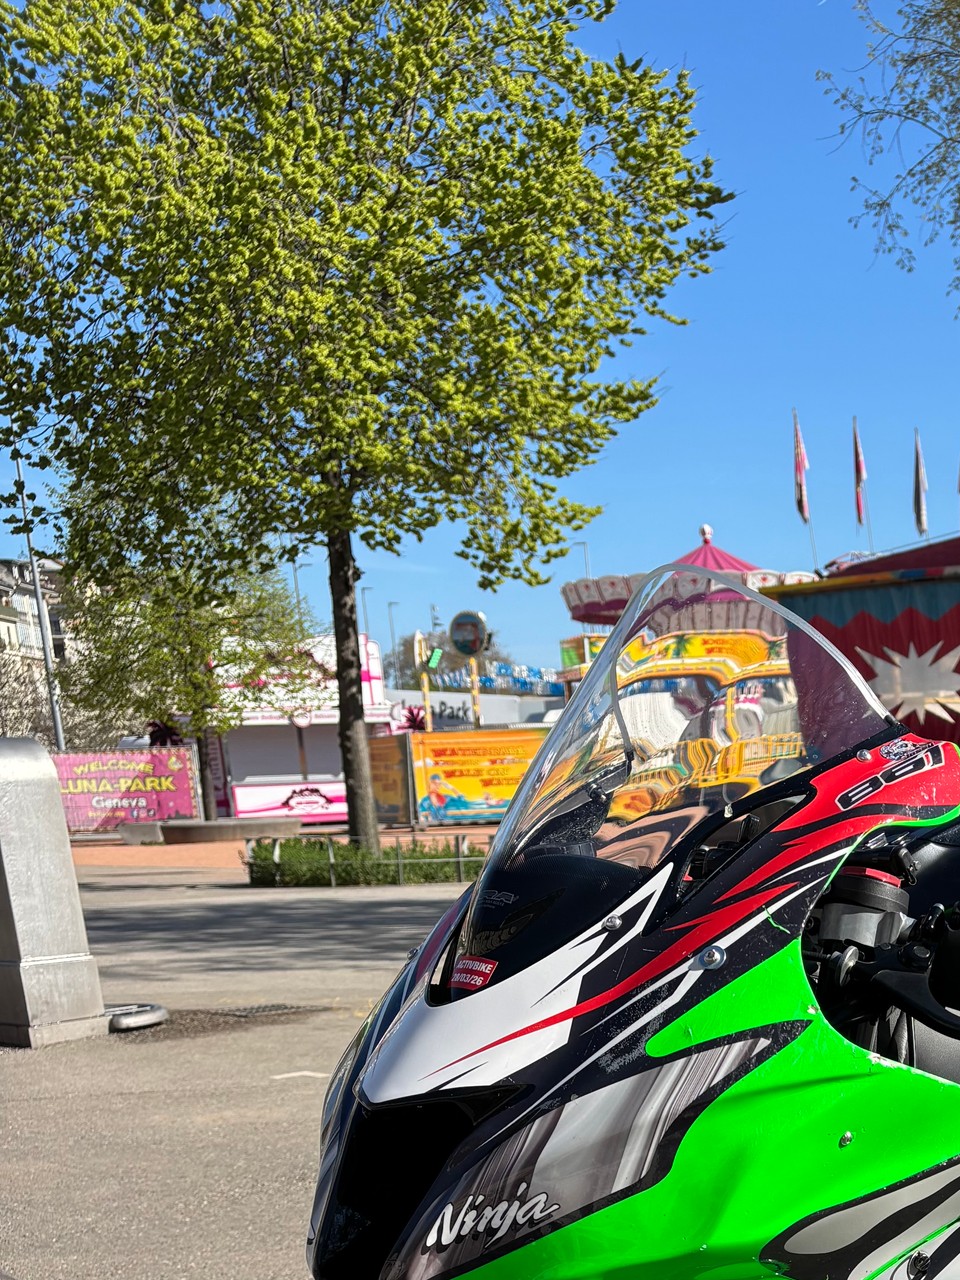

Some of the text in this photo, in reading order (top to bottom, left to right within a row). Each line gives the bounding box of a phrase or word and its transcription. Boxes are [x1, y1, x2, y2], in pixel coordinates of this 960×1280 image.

[439, 700, 470, 722] Park
[73, 760, 155, 776] WELCOME
[91, 796, 147, 809] Geneva
[456, 960, 494, 974] ACTIVBIKE
[425, 1181, 561, 1249] Ninja
